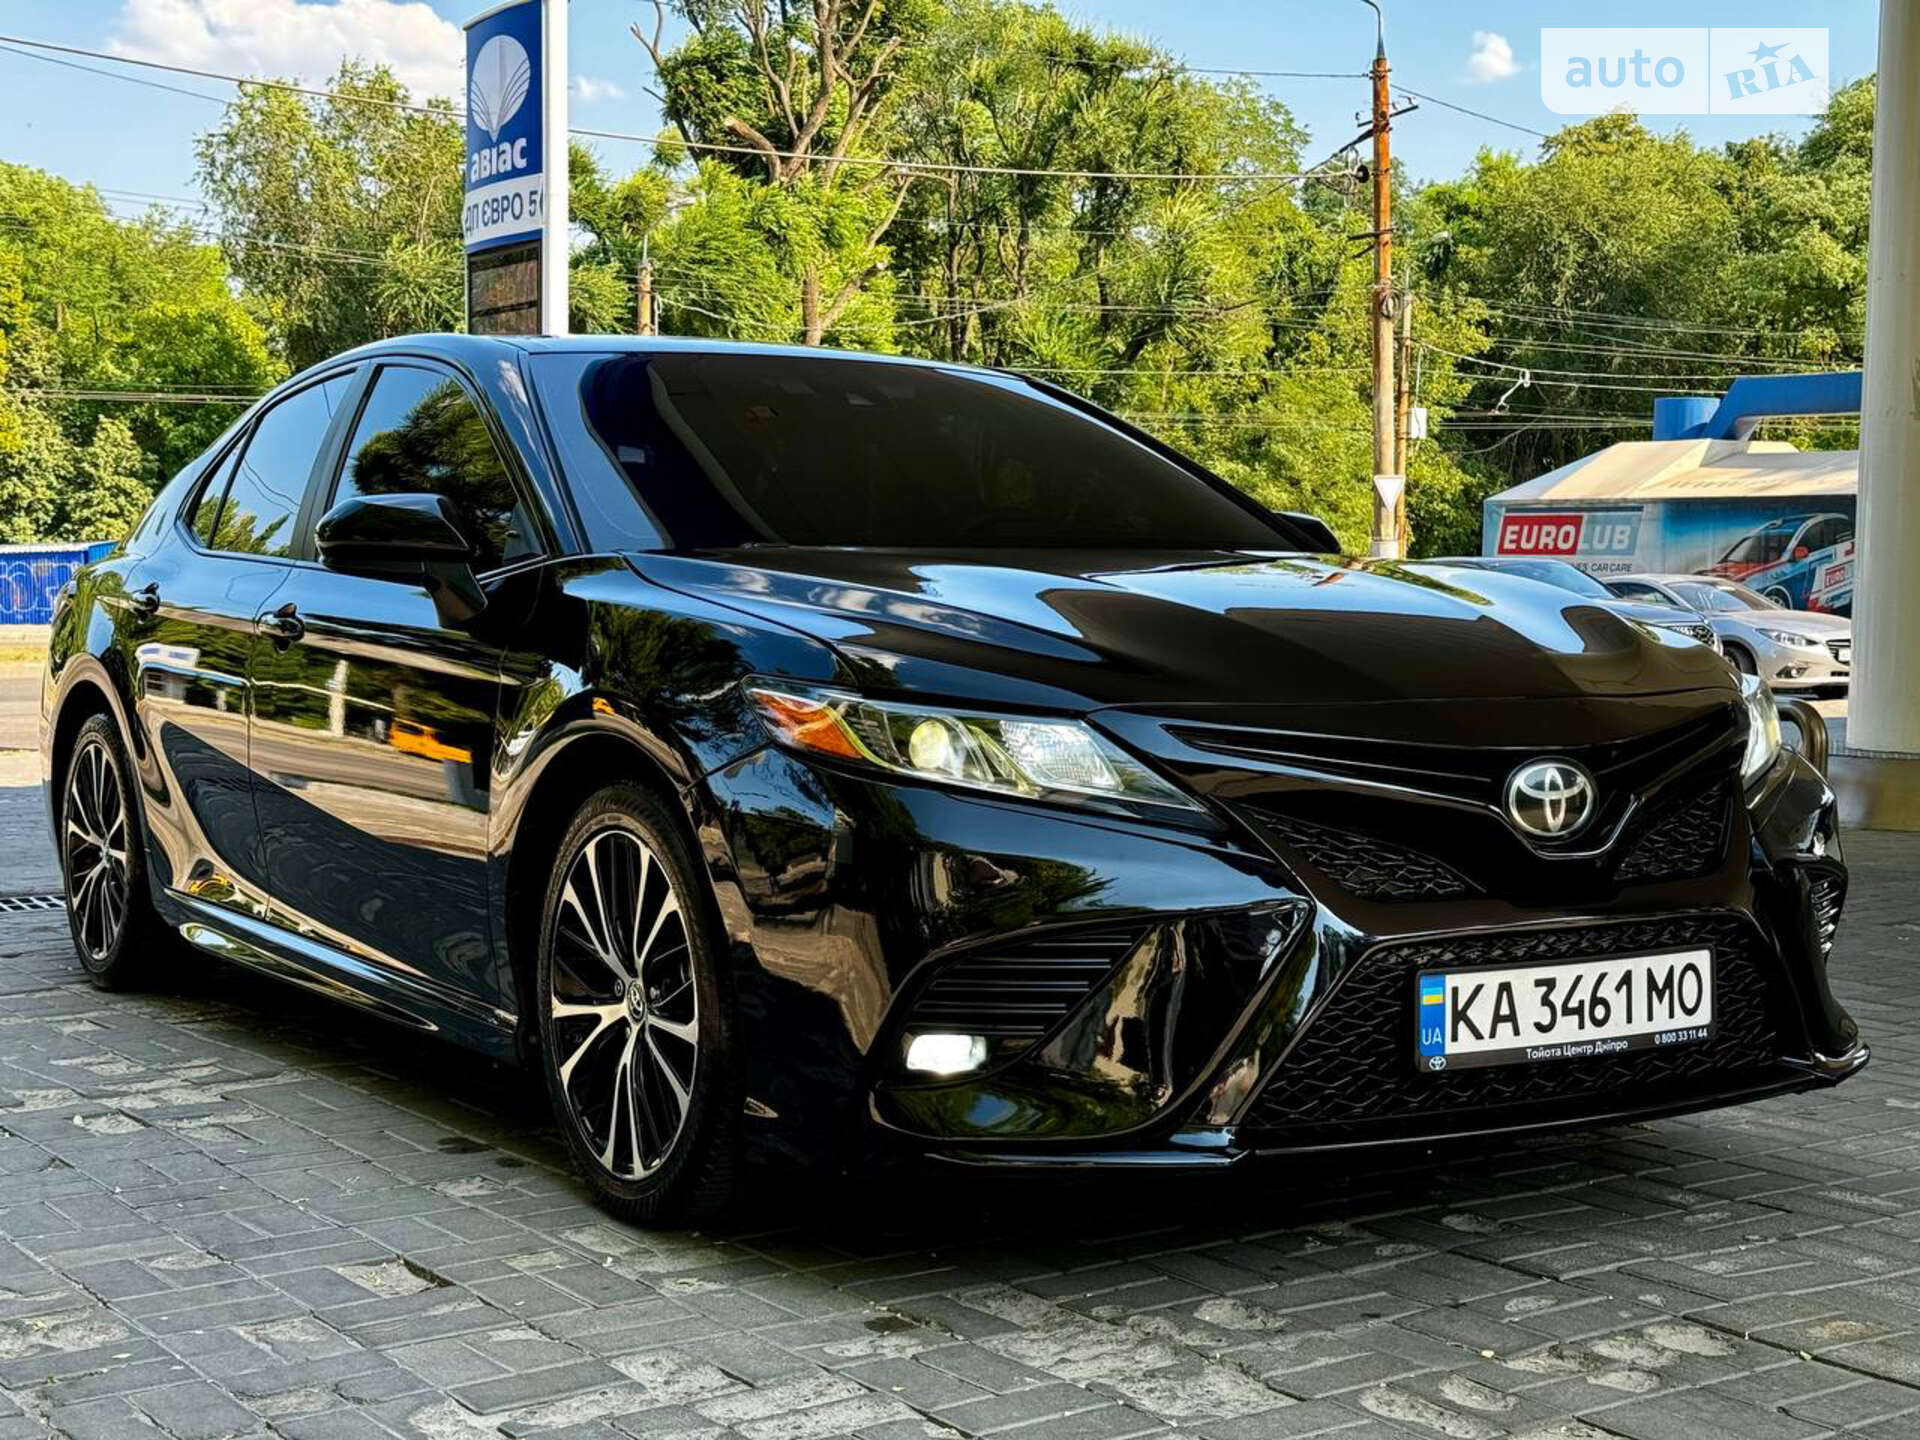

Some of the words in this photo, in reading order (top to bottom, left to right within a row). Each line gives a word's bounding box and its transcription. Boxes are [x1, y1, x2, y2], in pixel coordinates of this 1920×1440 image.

[482, 192, 523, 227] ЄВРО
[1503, 524, 1632, 550] EUROLUB
[1533, 969, 1633, 1034] 3461
[1421, 1027, 1443, 1046] UA
[1677, 1031, 1688, 1042] 33
[1526, 1046, 1562, 1060] Тойота
[1562, 1042, 1594, 1057] Центр
[1594, 1039, 1629, 1055] Дніпро
